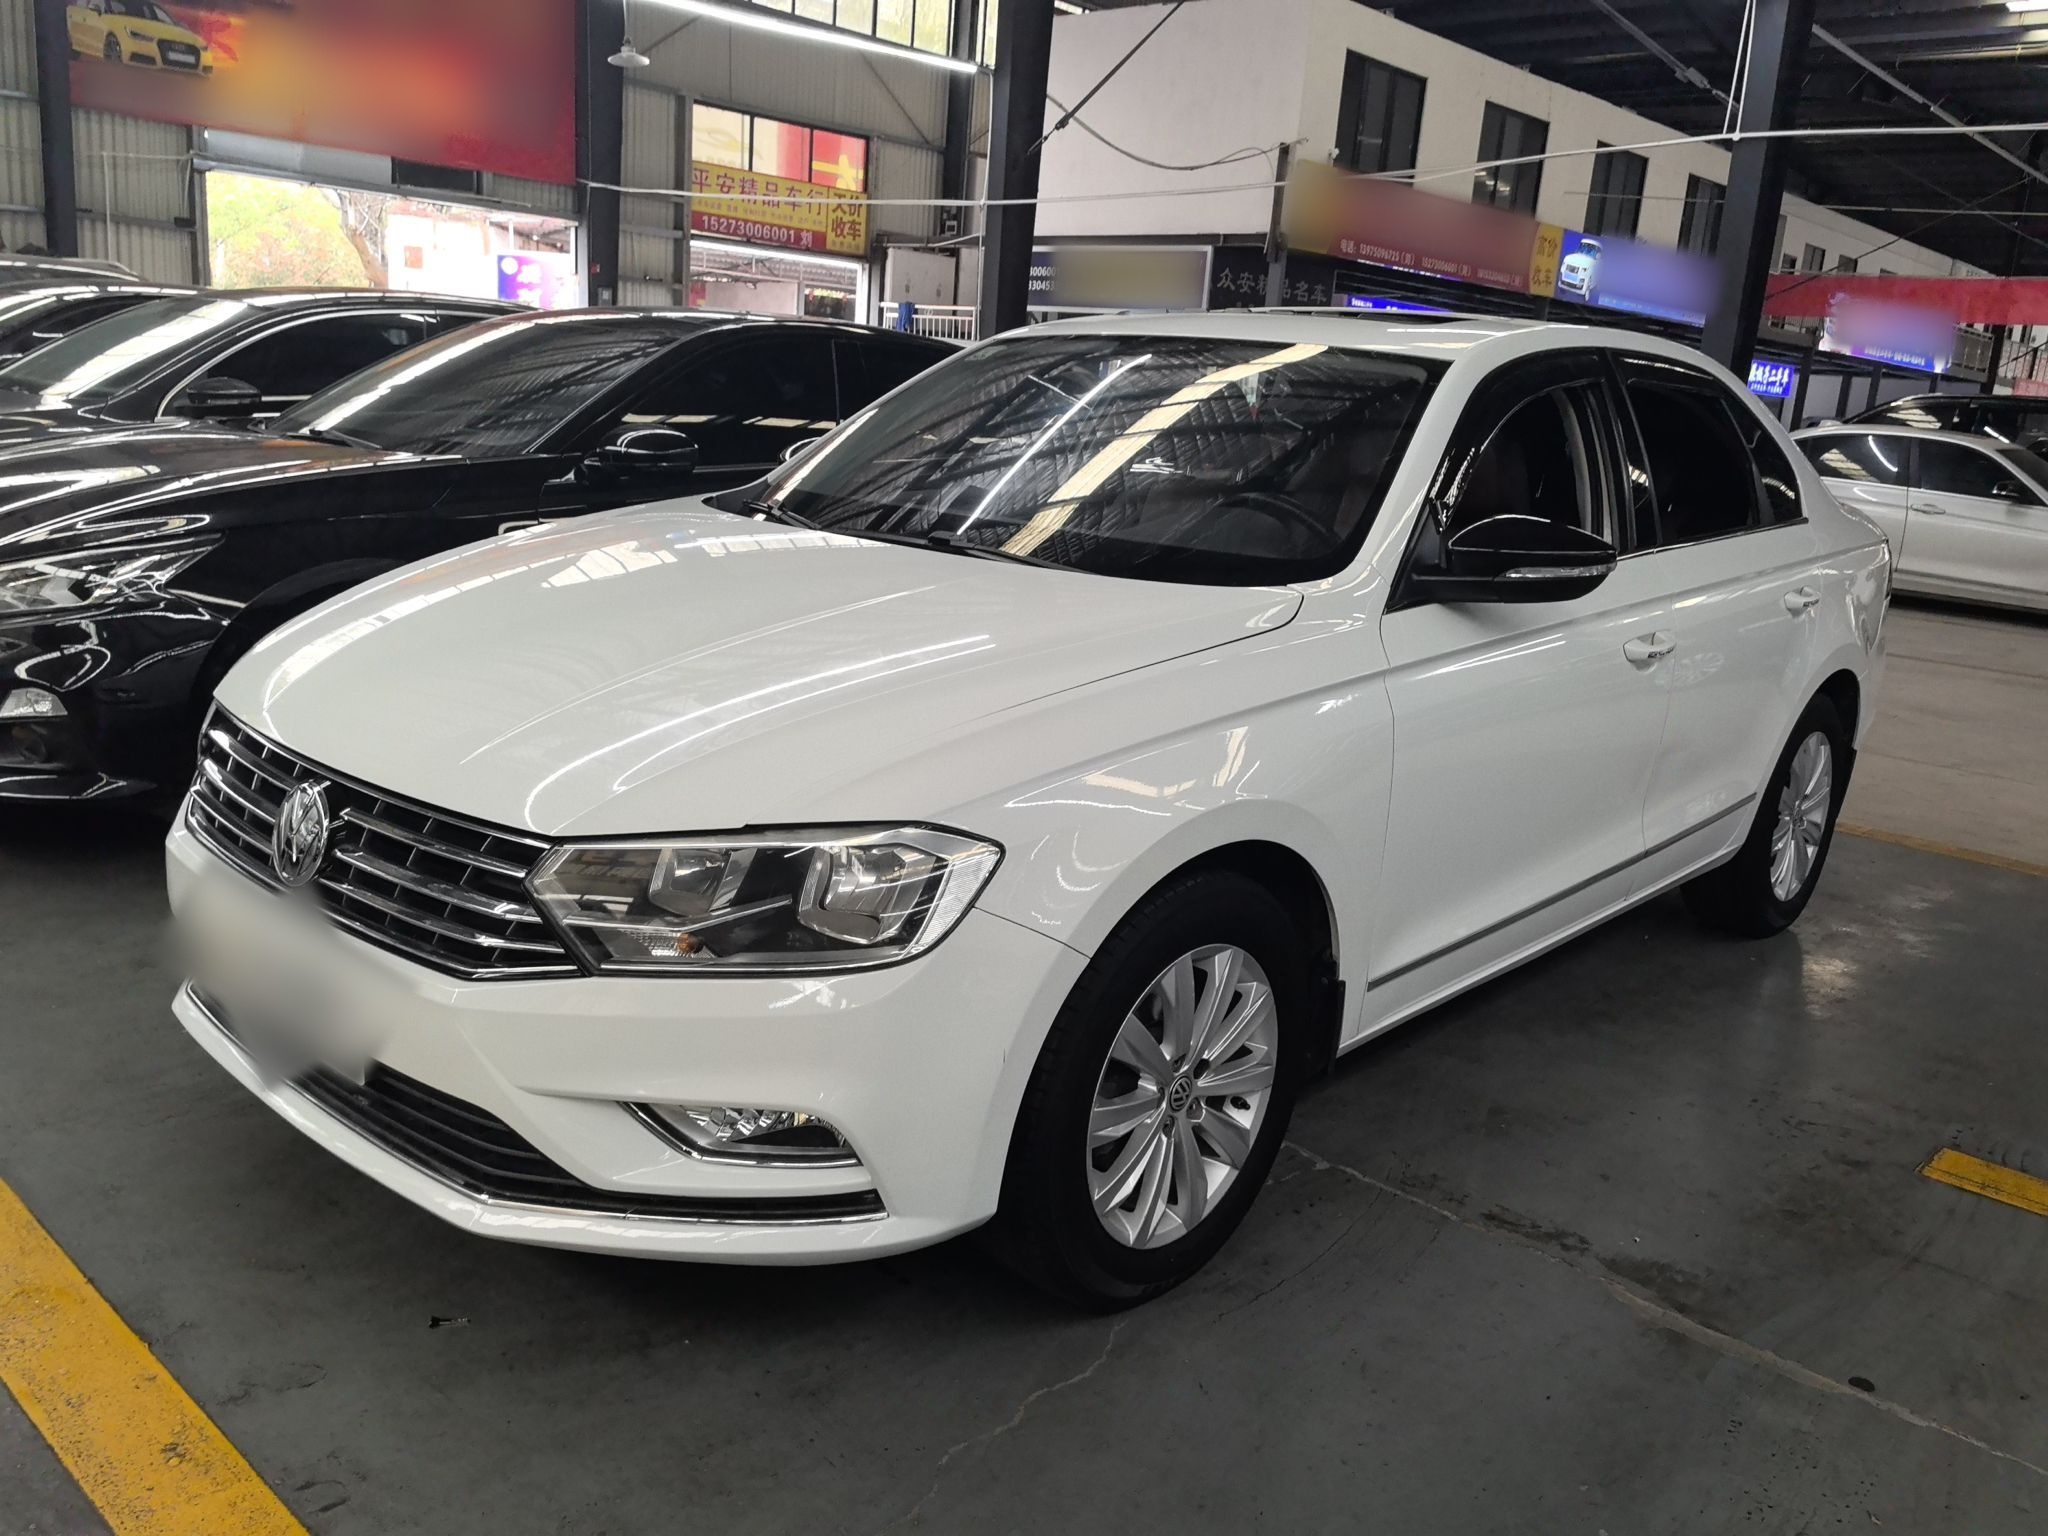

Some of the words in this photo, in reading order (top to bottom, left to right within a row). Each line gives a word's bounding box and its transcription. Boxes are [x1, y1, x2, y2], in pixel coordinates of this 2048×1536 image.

[692, 168, 824, 216] 平安精品车行
[702, 215, 796, 243] 15273006001
[800, 230, 813, 248] 刘
[832, 217, 862, 241] 收车
